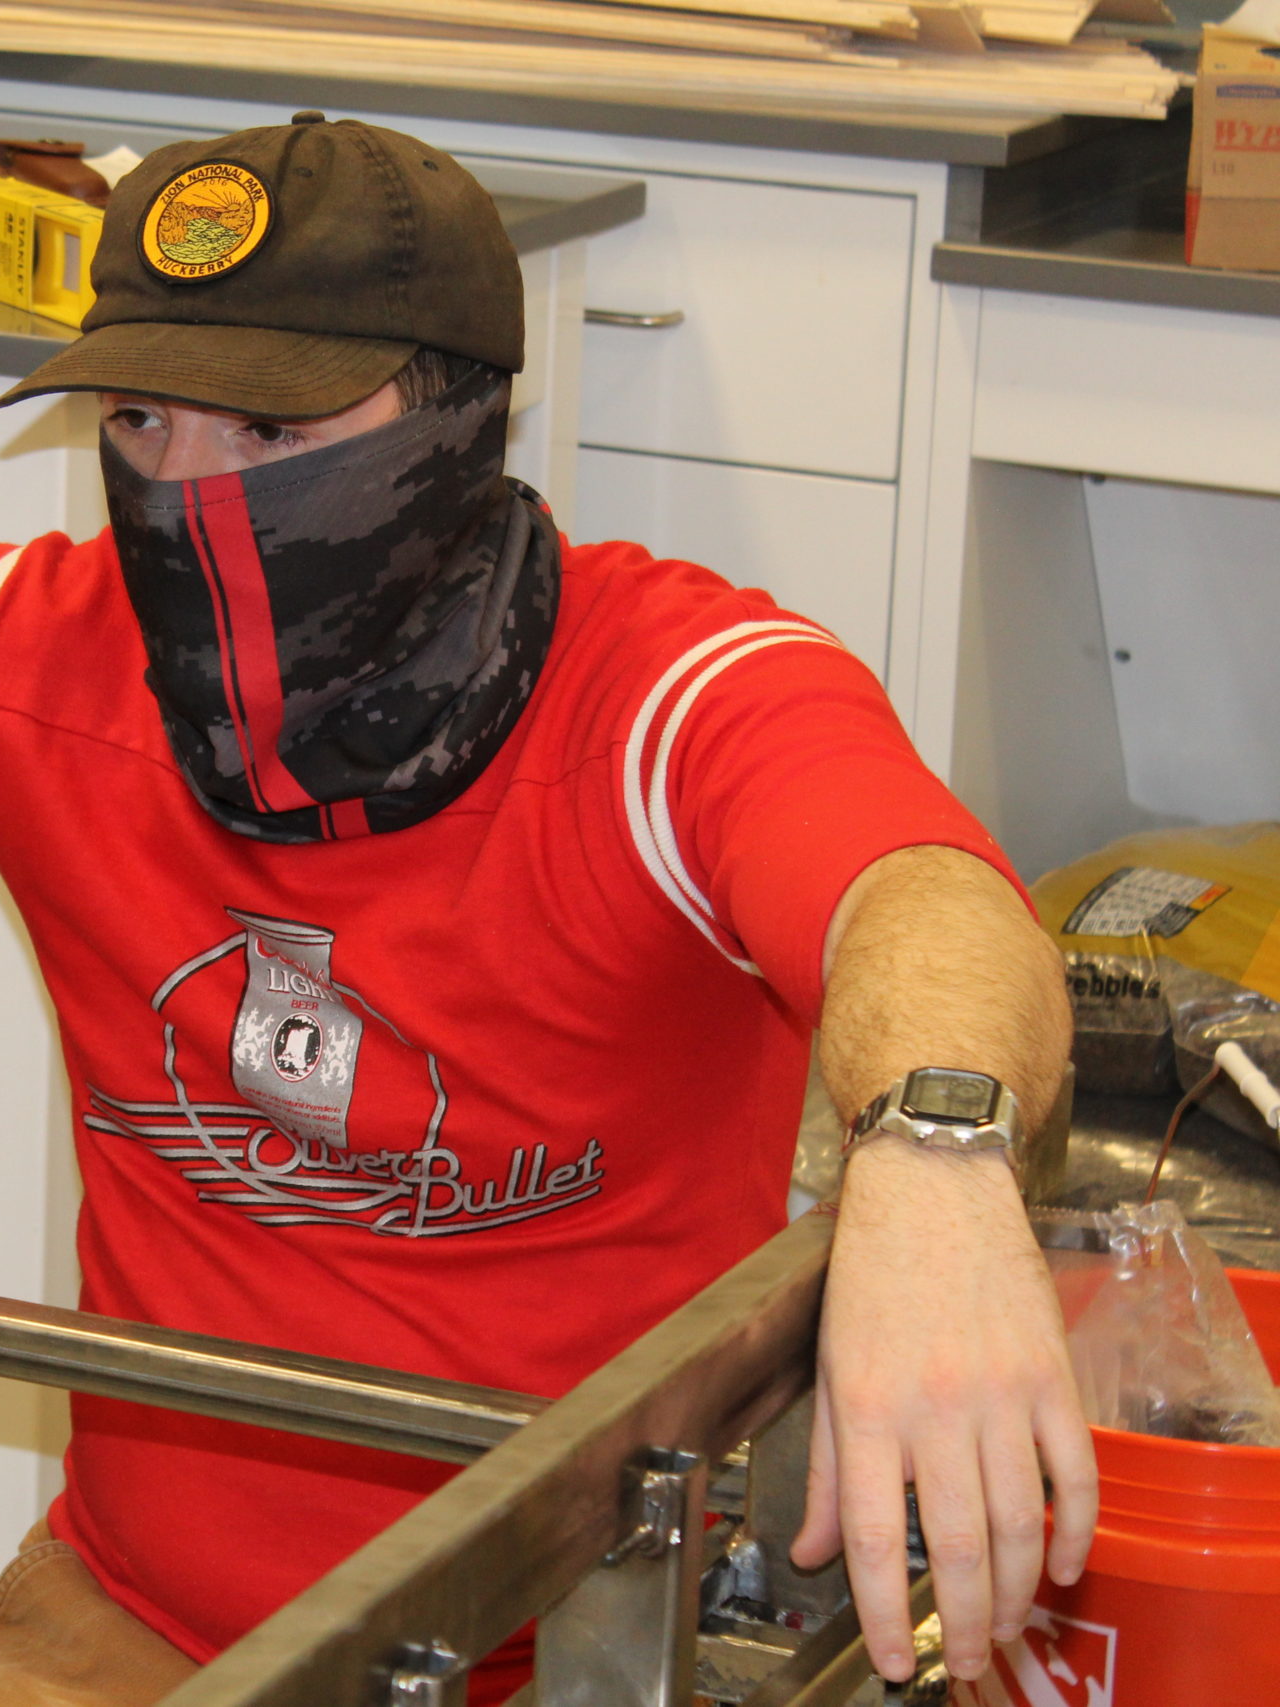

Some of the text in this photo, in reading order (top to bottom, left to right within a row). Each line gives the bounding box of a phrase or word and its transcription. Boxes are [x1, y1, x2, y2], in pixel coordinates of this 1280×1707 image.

[161, 165, 265, 204] ZION NATIONAL PARK
[156, 256, 234, 276] HUCKBERRY
[290, 999, 319, 1011] BEER
[407, 1139, 604, 1237] Bullet
